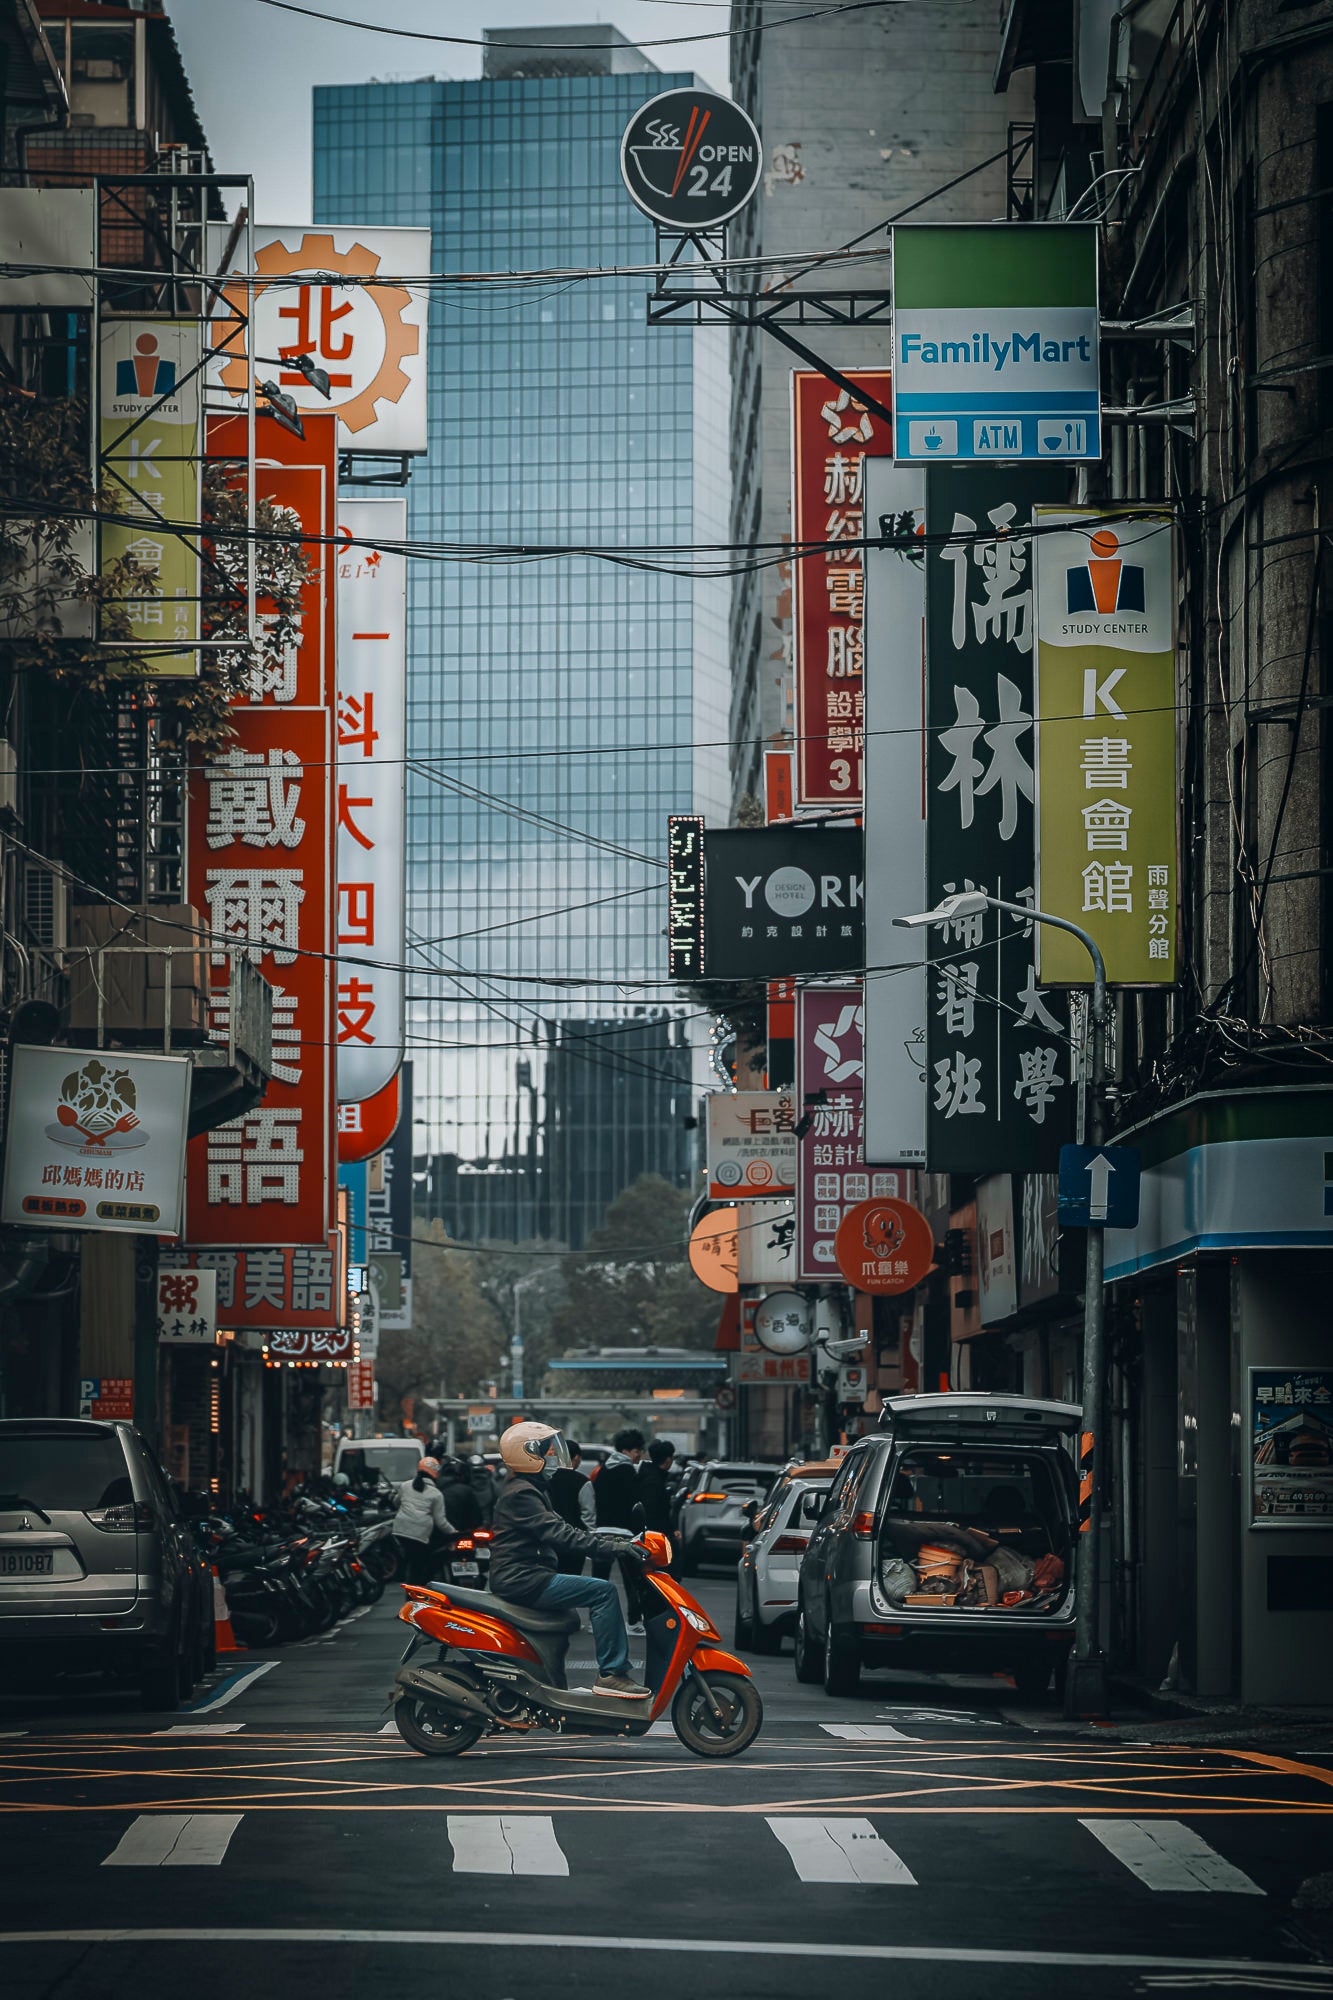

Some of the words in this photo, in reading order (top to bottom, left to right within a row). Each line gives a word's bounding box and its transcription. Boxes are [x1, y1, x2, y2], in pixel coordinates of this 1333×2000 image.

[699, 146, 752, 162] OPEN
[687, 166, 732, 197] 24
[901, 332, 1091, 371] FamilyMart
[112, 404, 142, 412] STUDY
[144, 404, 179, 413] CNTER
[978, 424, 1018, 449] ATM
[1062, 624, 1101, 635] STUDY
[1103, 623, 1149, 635] CENTER
[937, 502, 1035, 841] 儒林
[1079, 668, 1133, 914] K書會館
[1147, 864, 1169, 960] 雨聲分館
[204, 748, 306, 1205] 戴爾美語
[42, 1165, 145, 1192] 邱媽媽的店
[159, 1274, 199, 1315] 粥
[885, 1277, 905, 1285] CATCH
